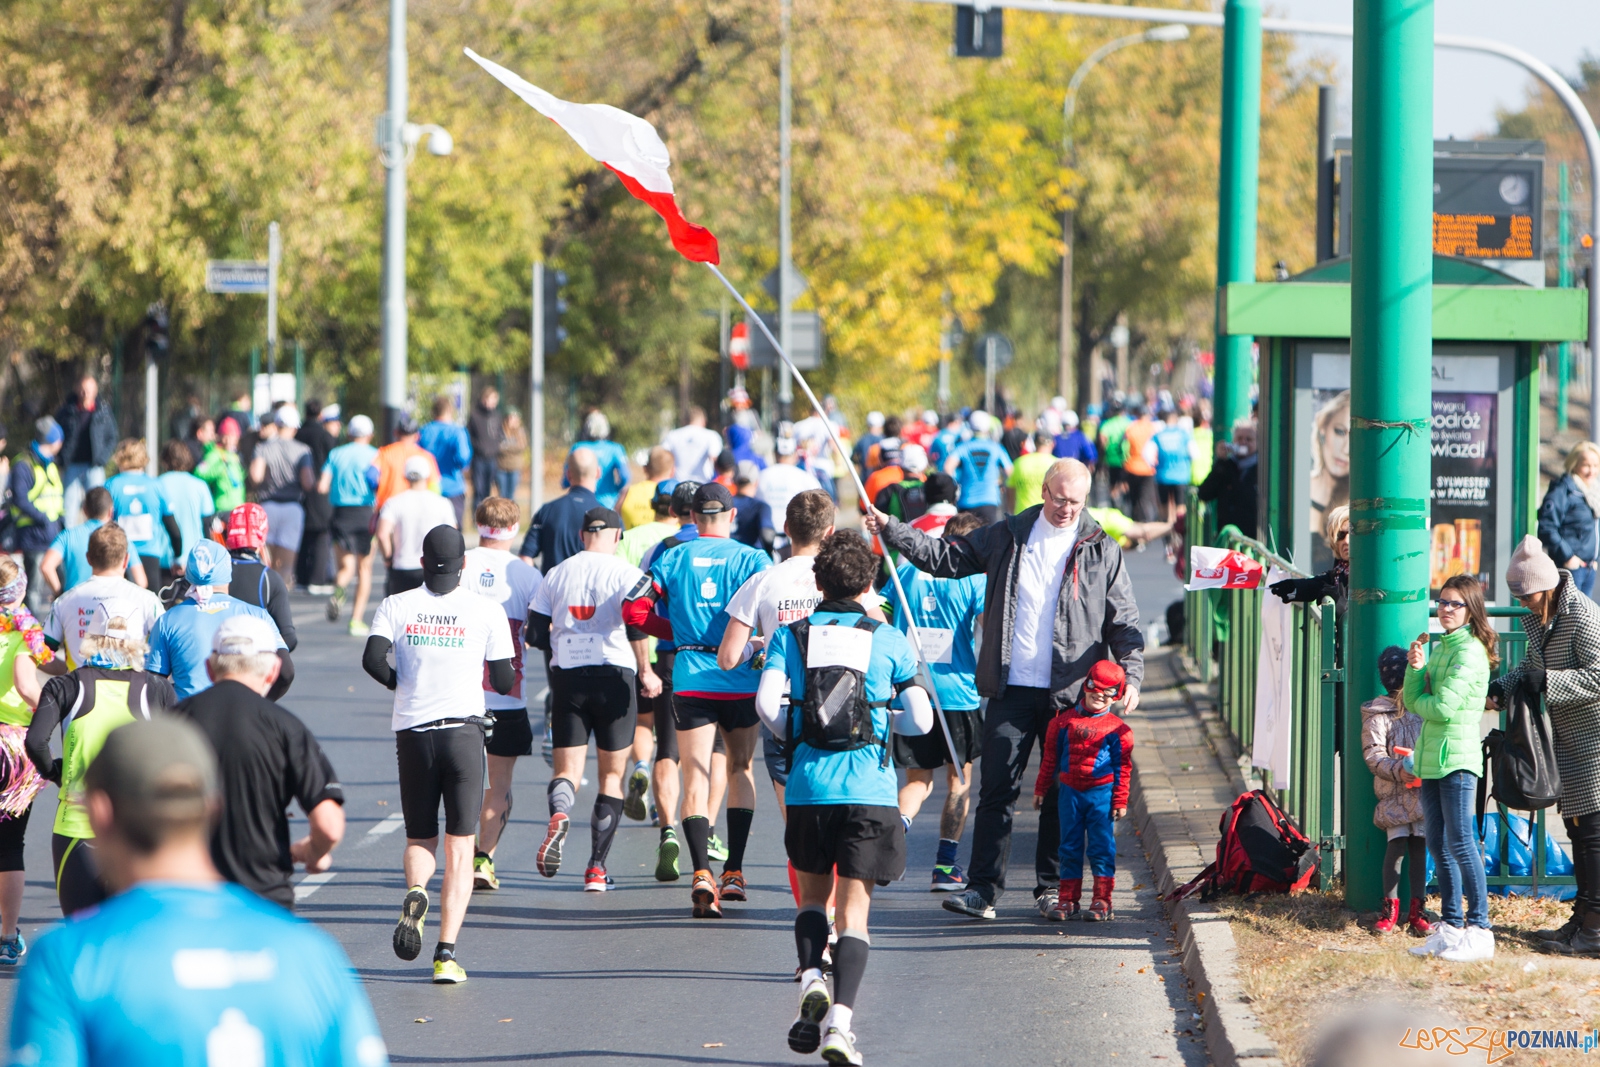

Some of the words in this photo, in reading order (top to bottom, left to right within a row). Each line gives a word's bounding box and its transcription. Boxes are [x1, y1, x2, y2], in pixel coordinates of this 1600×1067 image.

[1432, 366, 1454, 380] AL
[1431, 440, 1485, 458] wiazd!
[778, 597, 822, 610] ŁEMKOW
[416, 612, 458, 626] SŁYNNY
[778, 609, 809, 622] ULTRA
[405, 624, 466, 637] KENIJCZYK
[406, 635, 465, 649] TOMASZEK
